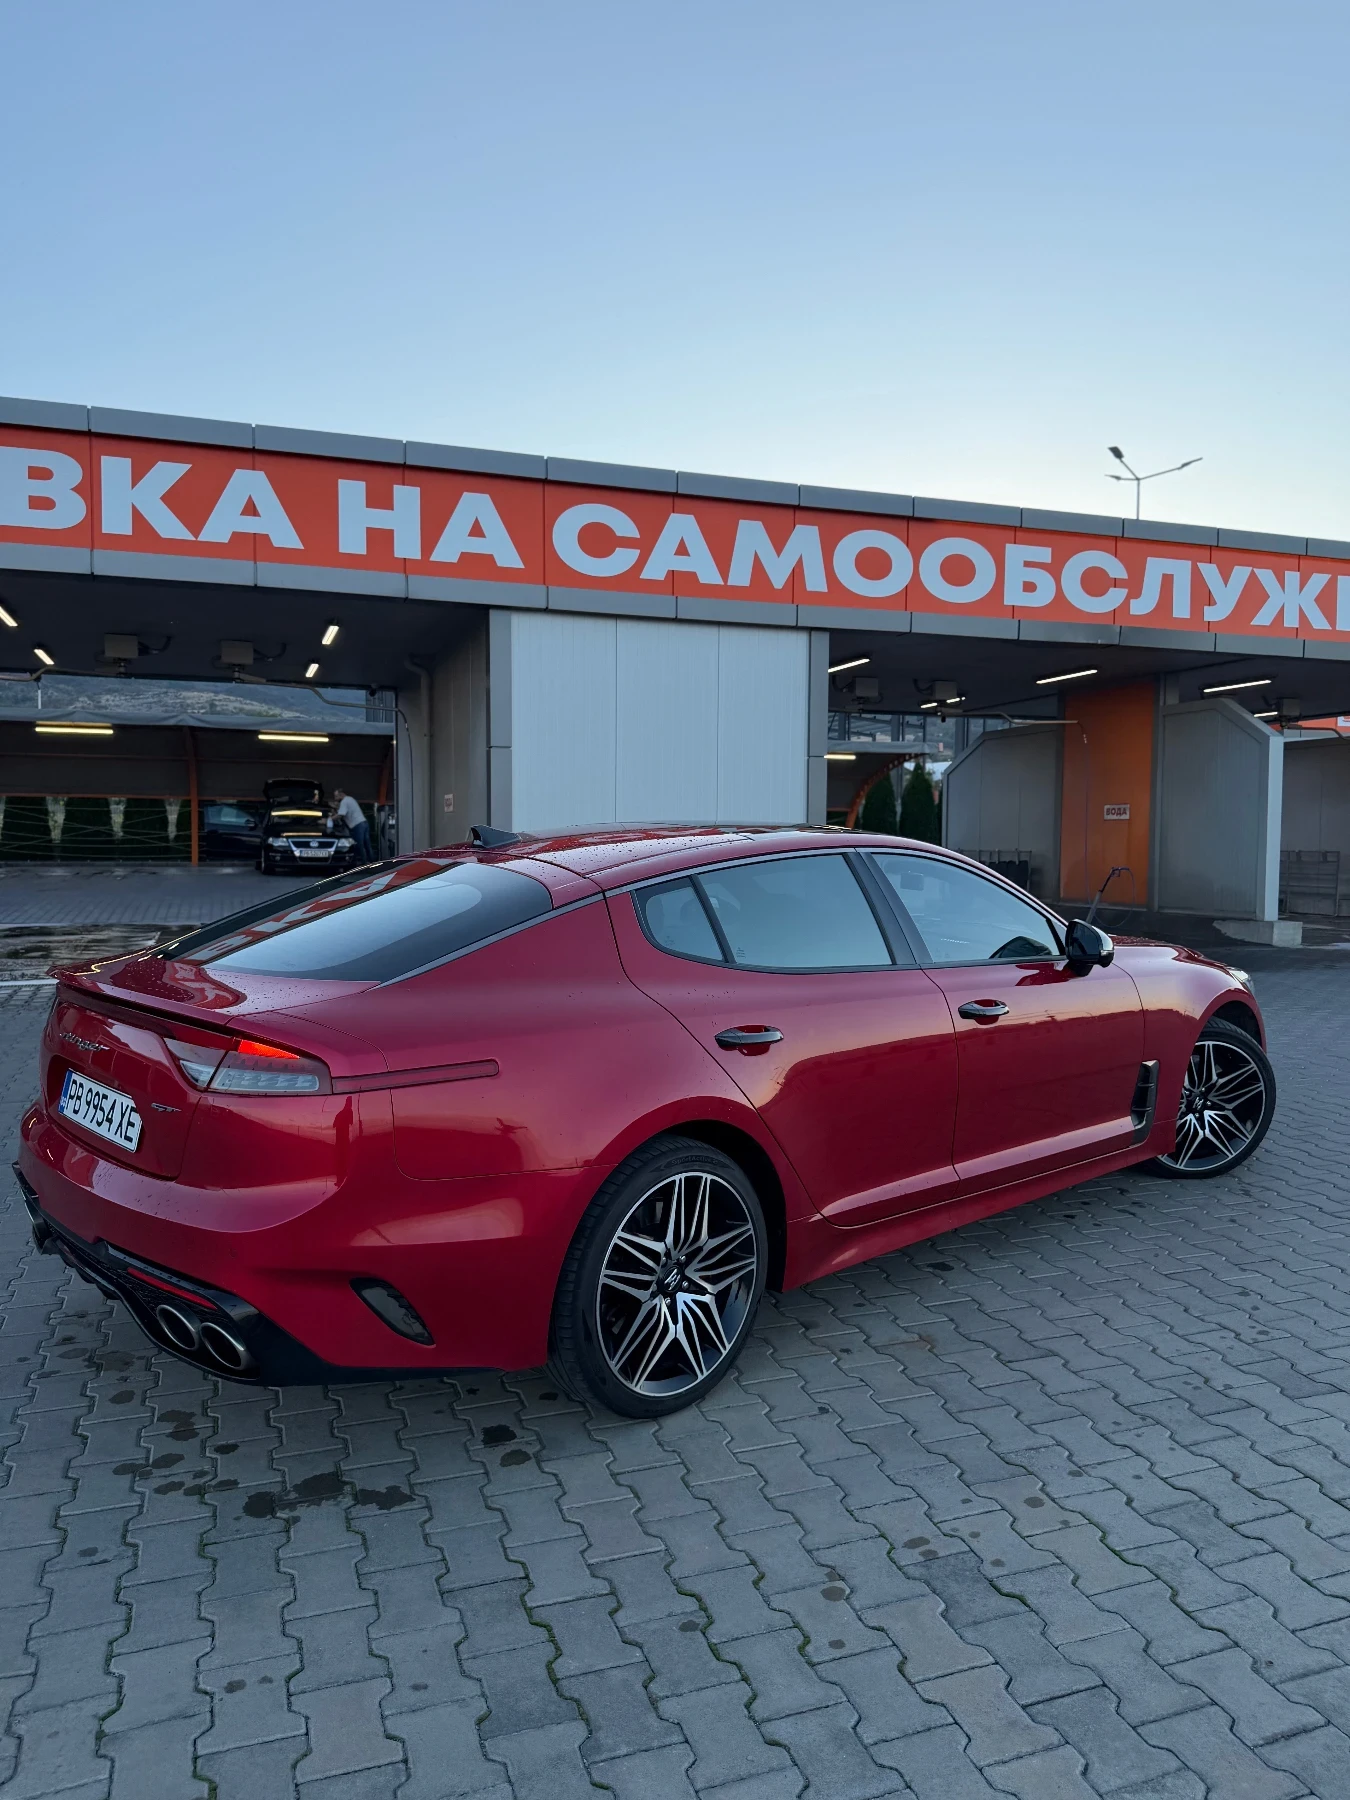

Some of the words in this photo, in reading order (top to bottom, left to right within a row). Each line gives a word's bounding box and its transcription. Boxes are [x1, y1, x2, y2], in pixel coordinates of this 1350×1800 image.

[0, 446, 304, 549] ВКА
[337, 479, 525, 569] НА
[1105, 807, 1127, 817] ВОДА
[66, 1078, 84, 1116] PB
[83, 1087, 117, 1133] 9954
[114, 1102, 138, 1143] XE
